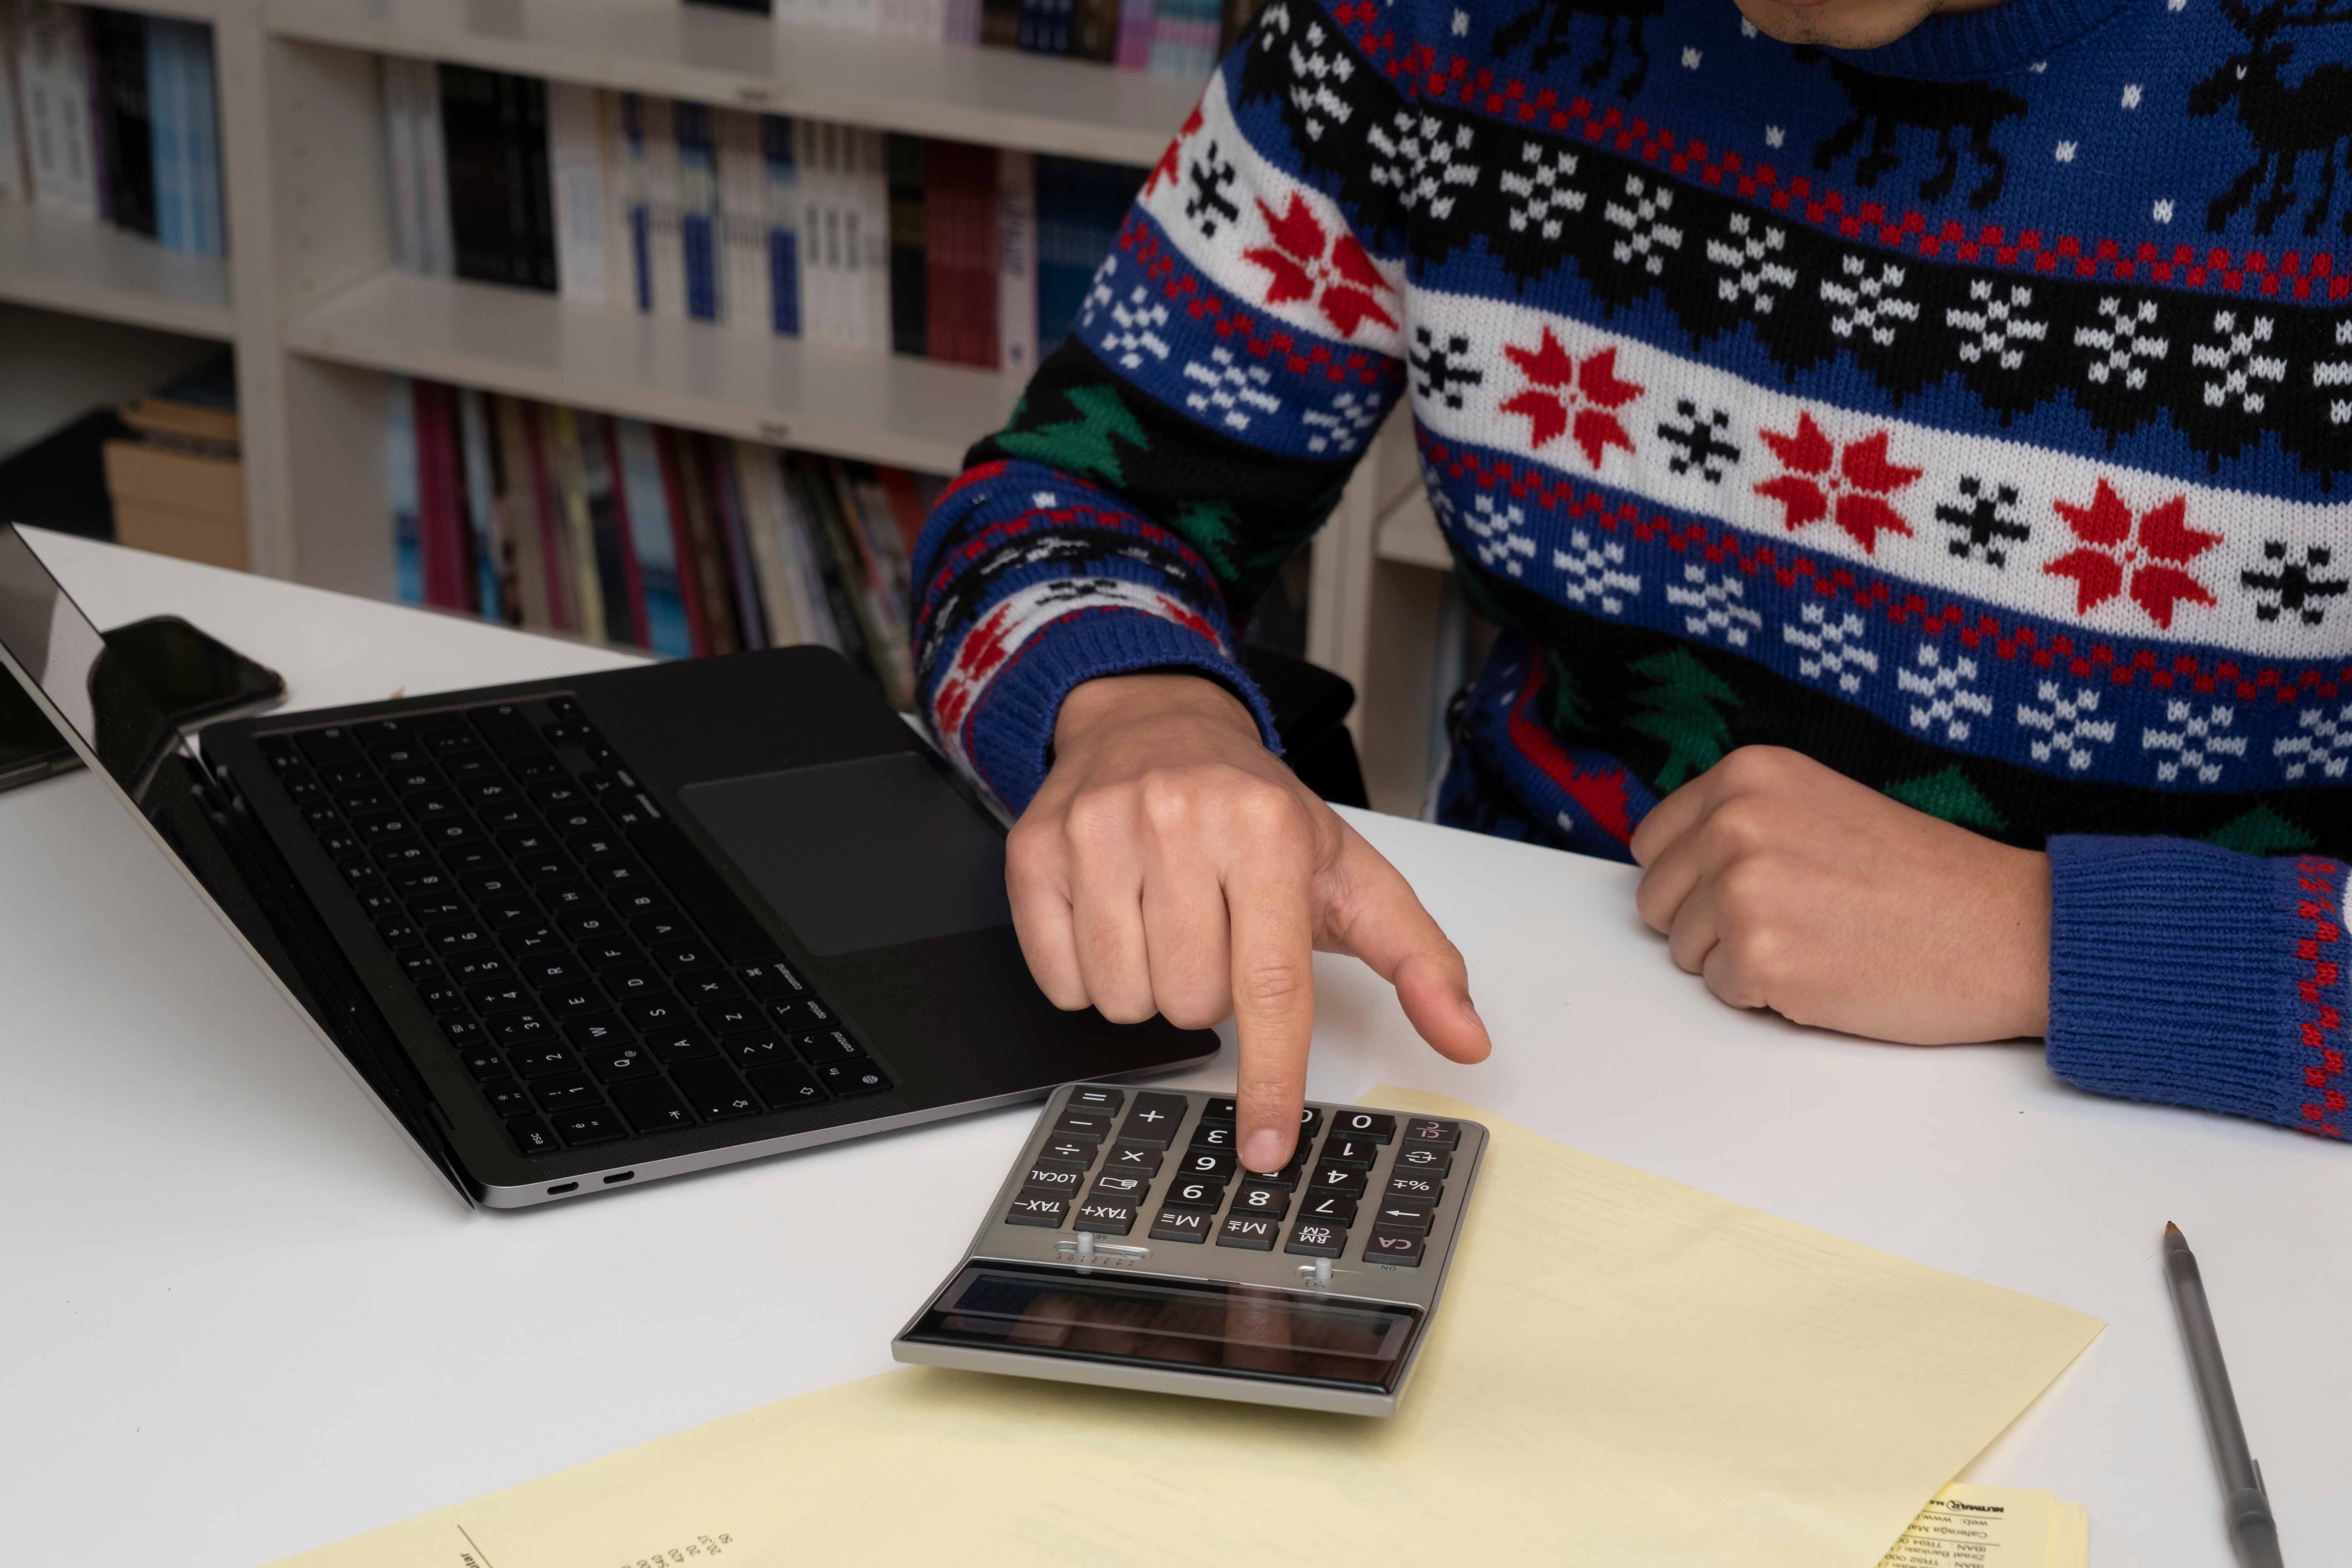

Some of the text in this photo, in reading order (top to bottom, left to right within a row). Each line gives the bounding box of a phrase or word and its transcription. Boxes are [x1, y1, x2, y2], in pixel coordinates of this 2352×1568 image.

[522, 838, 537, 847] K
[591, 842, 608, 851] M
[612, 869, 629, 878] N
[485, 882, 501, 890] U
[562, 892, 579, 901] H
[634, 897, 651, 905] B
[547, 966, 563, 975] R
[627, 978, 644, 987] D
[701, 983, 719, 991] X
[725, 1013, 743, 1021] Z
[589, 1027, 608, 1037] W
[830, 1031, 854, 1052] control
[614, 1058, 630, 1067] Q
[1352, 1115, 1372, 1128] 0
[530, 1133, 544, 1144] esc
[1207, 1130, 1228, 1143] 3
[1343, 1143, 1354, 1156] 1
[1195, 1157, 1216, 1170] 6
[1032, 1170, 1076, 1184] LOCAL
[1327, 1170, 1348, 1183] 4
[1183, 1185, 1204, 1199] 9
[1248, 1191, 1270, 1206] 8
[1315, 1199, 1334, 1213] 7
[1081, 1206, 1127, 1219] TAX+
[1303, 1227, 1330, 1235] CM
[1300, 1234, 1327, 1244] RM
[1378, 1237, 1412, 1250] CA
[686, 1545, 701, 1556] 20
[1957, 1544, 1986, 1552] IBAN
